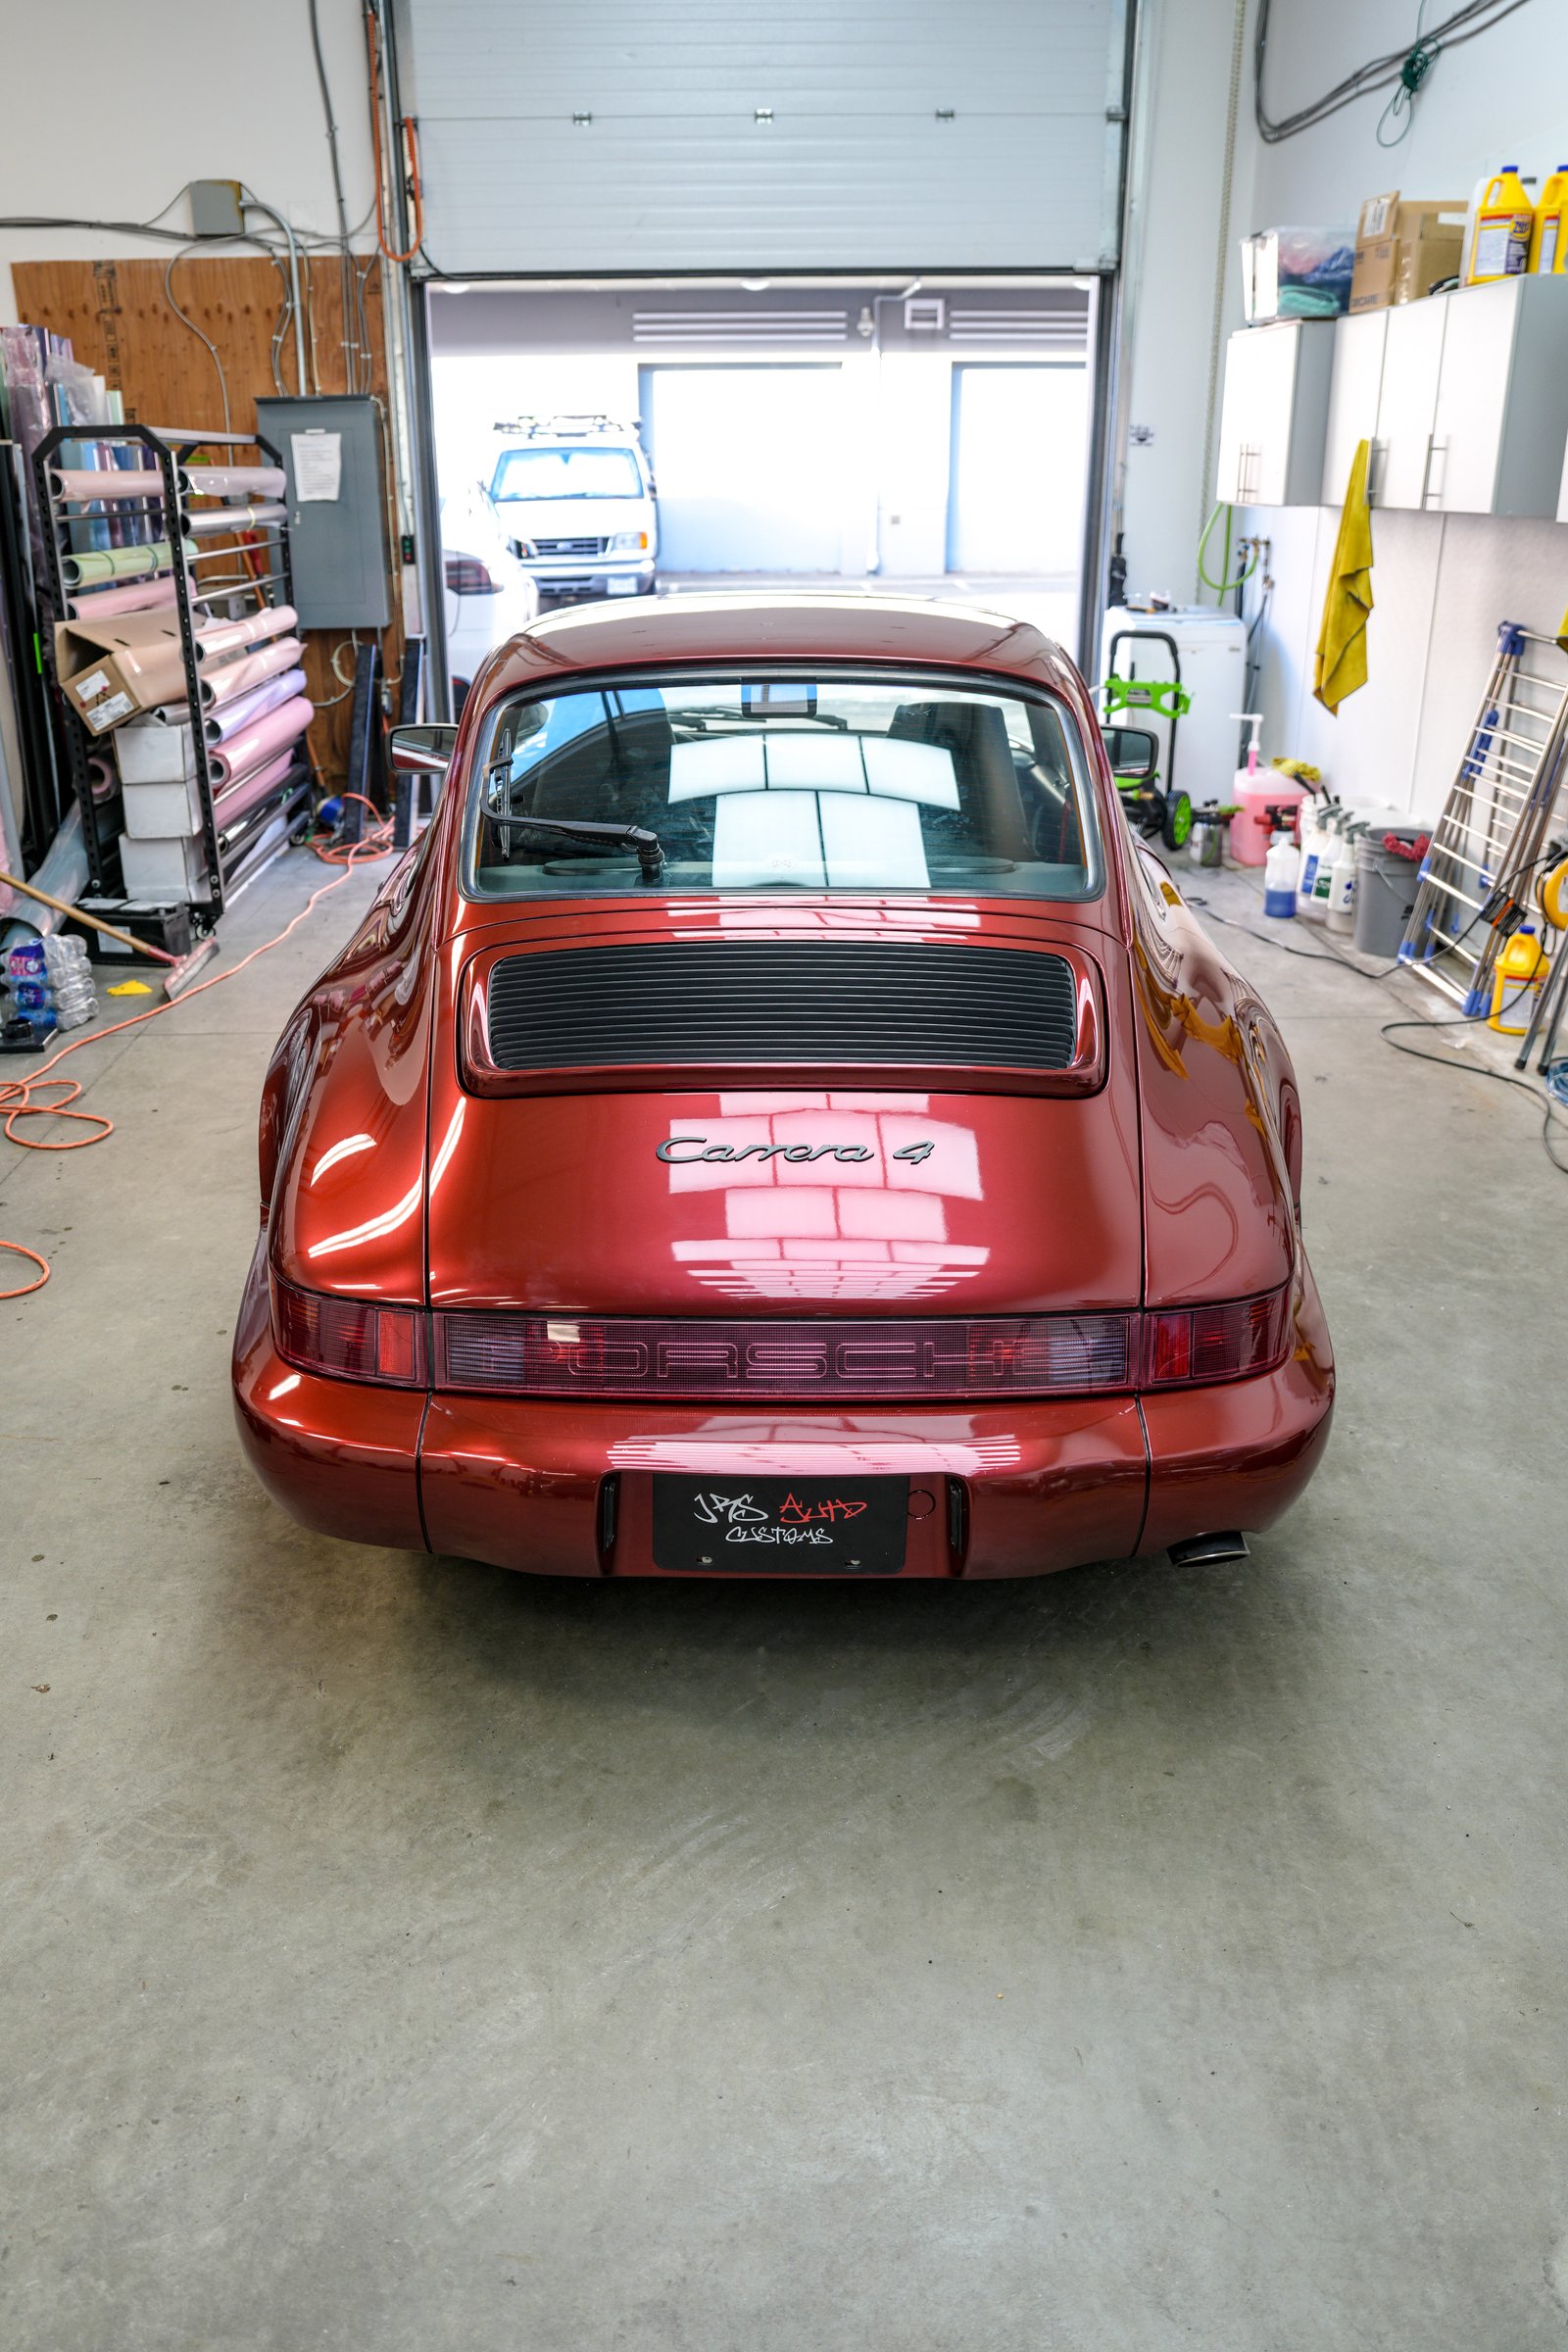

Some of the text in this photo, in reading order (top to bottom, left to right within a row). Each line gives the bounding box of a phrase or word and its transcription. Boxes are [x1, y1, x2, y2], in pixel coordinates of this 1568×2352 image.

[655, 1136, 936, 1165] Carrera 4
[482, 1336, 1093, 1379] PORSCHE
[725, 1526, 834, 1544] CUSTOMS
